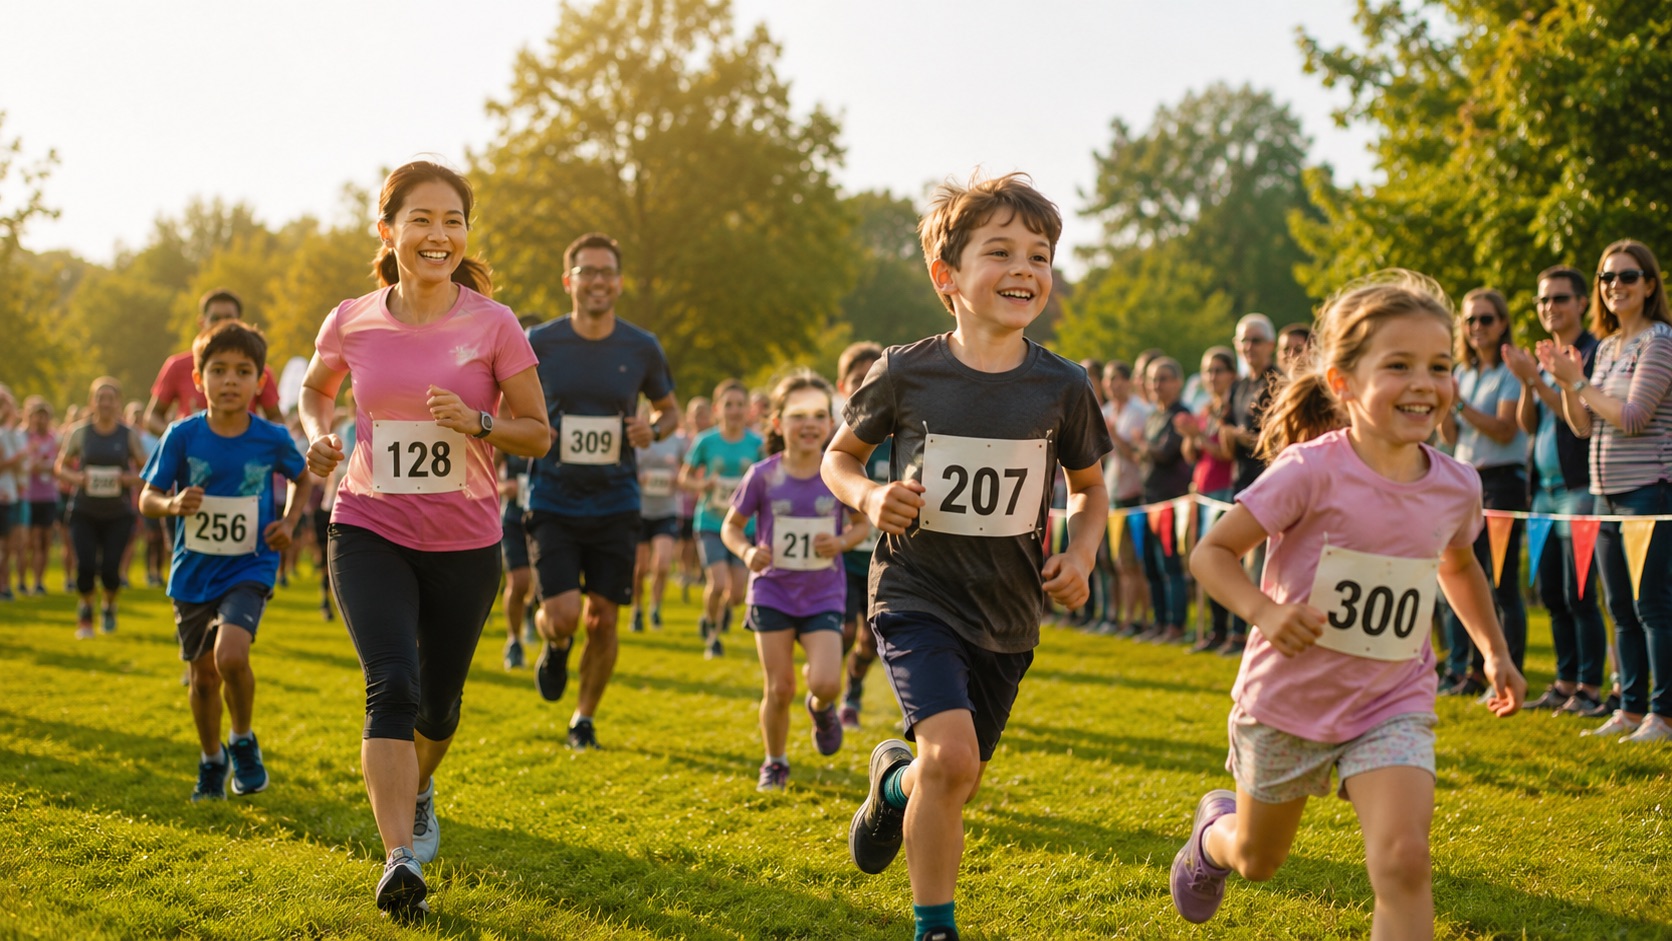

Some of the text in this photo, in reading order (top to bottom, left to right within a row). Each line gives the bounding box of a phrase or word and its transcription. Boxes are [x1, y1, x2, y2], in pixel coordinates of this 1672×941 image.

[387, 441, 452, 478] 128
[570, 430, 613, 455] 309
[939, 464, 1028, 516] 207
[195, 510, 247, 544] 256
[783, 532, 822, 559] 21
[1327, 579, 1420, 639] 300
